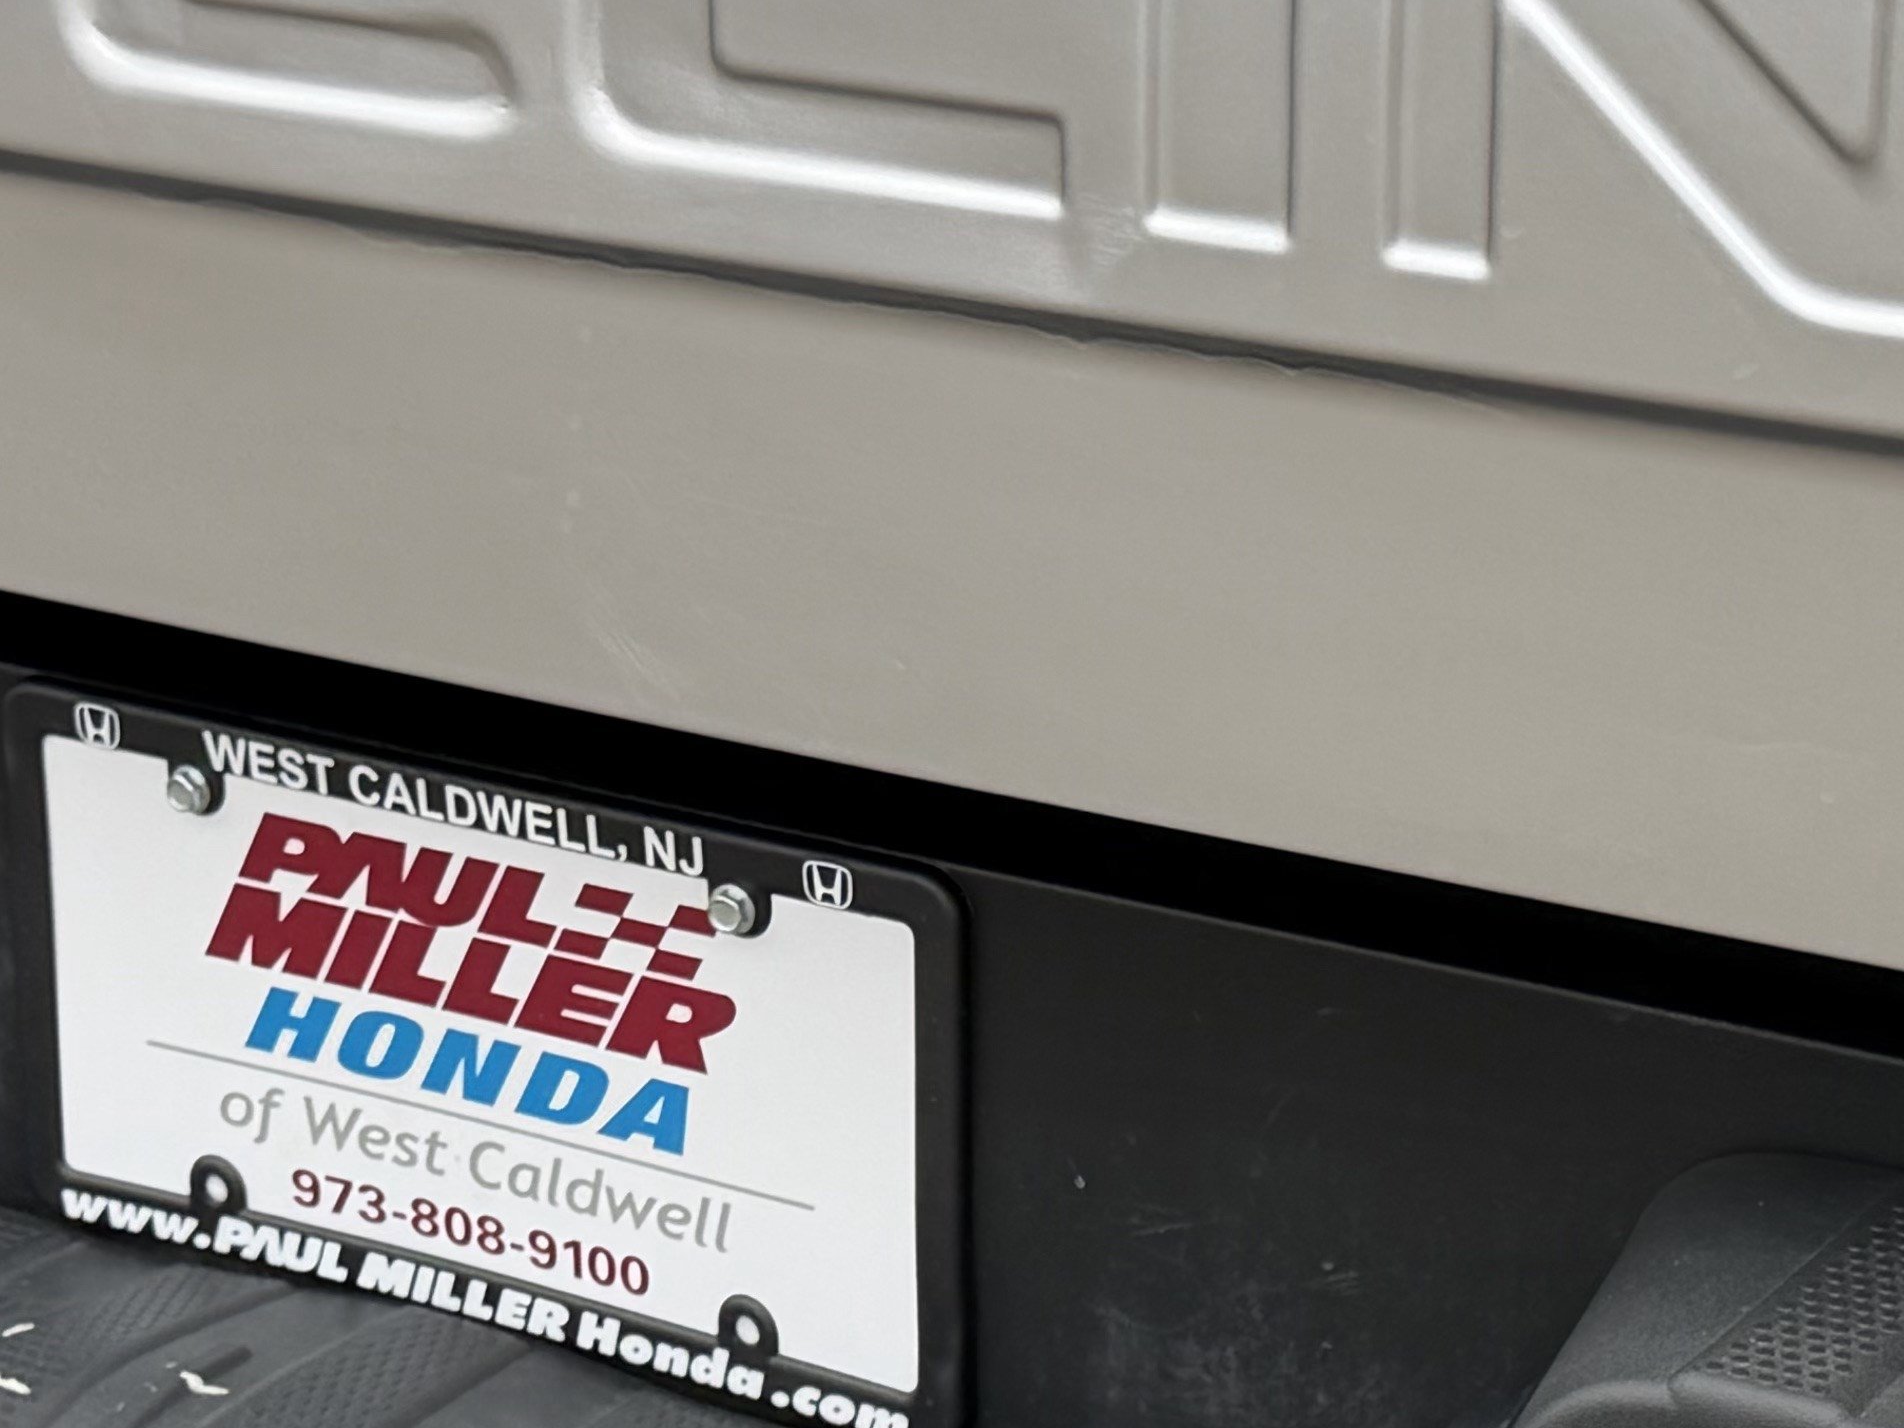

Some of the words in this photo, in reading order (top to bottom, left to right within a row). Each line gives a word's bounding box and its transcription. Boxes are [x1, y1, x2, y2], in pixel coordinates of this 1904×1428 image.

[202, 729, 334, 796] WEST
[348, 764, 629, 863] CALDWELL,
[642, 828, 706, 878] NJ
[238, 812, 564, 947] PAUL
[205, 884, 737, 1074] MILLER
[244, 986, 692, 1156] HONDA
[219, 1086, 283, 1143] of
[302, 1096, 447, 1176] West
[468, 1142, 732, 1253] Caldwell
[290, 1168, 650, 1296] 973-808-9100
